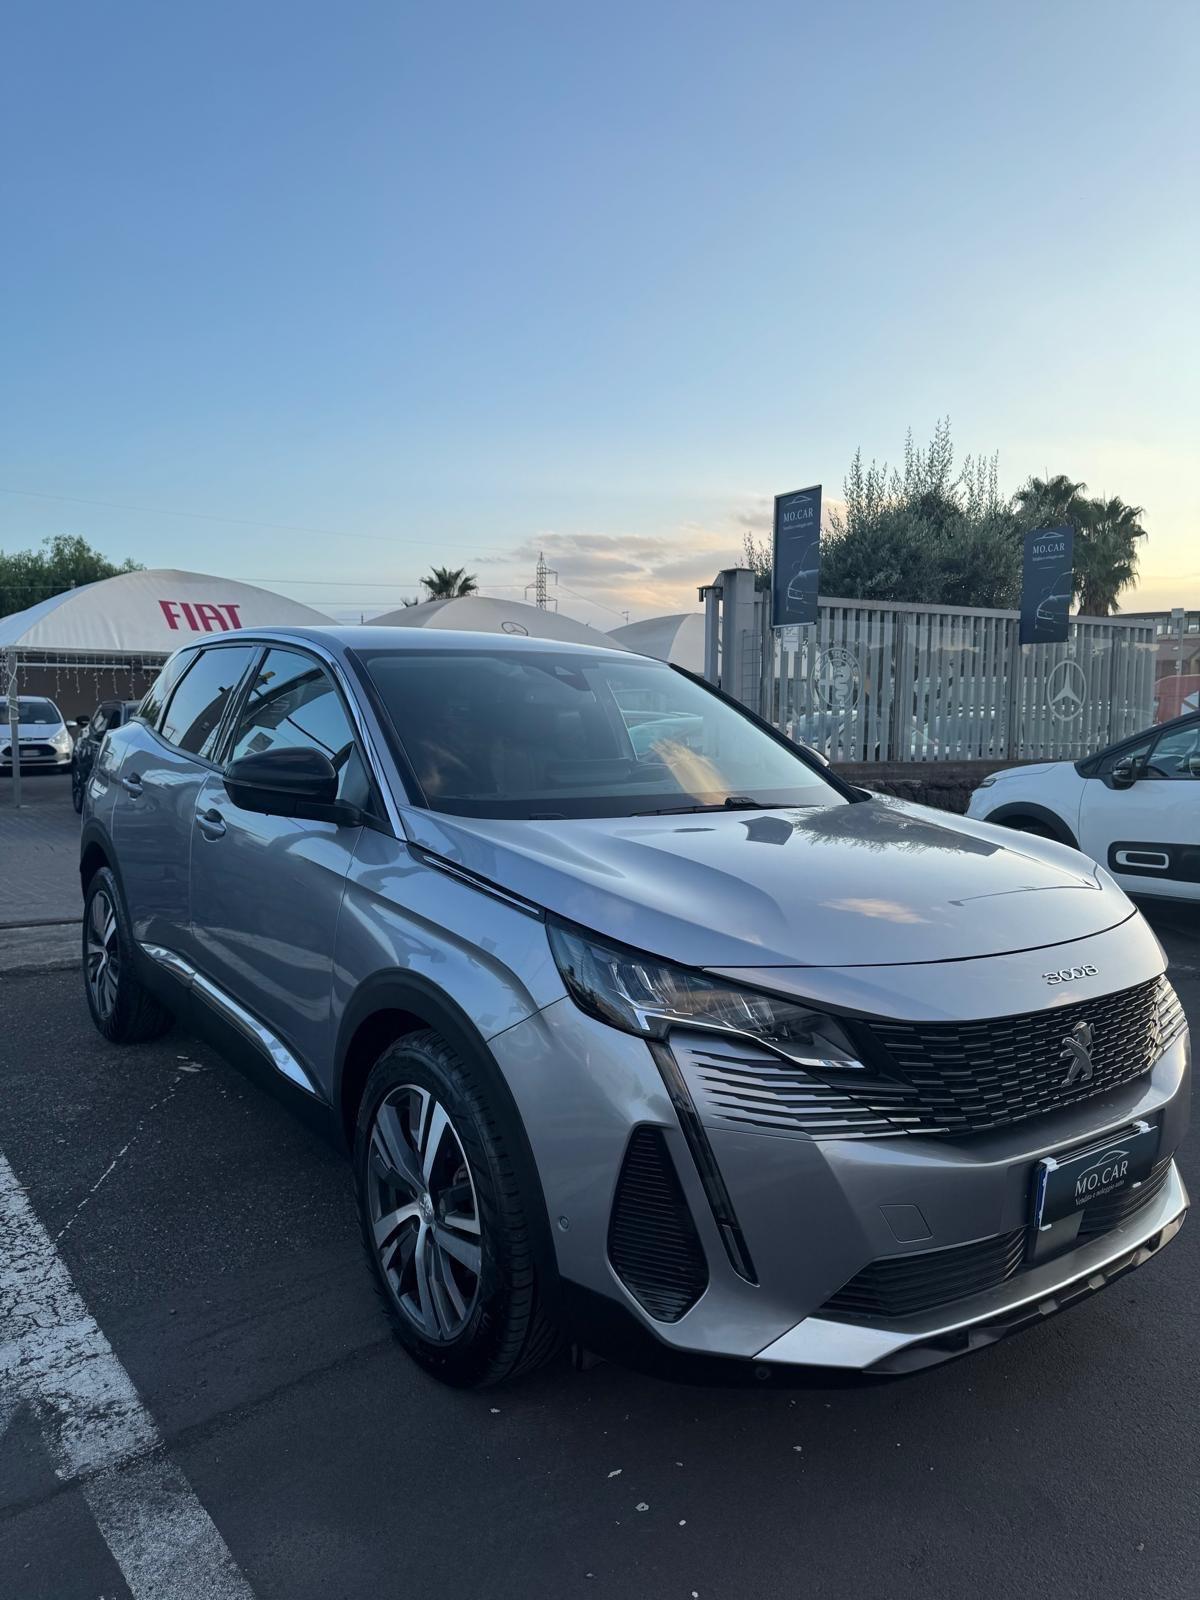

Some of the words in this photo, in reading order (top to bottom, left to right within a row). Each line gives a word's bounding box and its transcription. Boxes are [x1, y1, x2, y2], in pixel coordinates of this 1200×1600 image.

[783, 507, 813, 523] MO.CAR
[1032, 542, 1065, 555] MO.CAR
[158, 600, 242, 632] FIAT
[1042, 964, 1098, 985] 3008
[1075, 1160, 1128, 1197] MO.CAR
